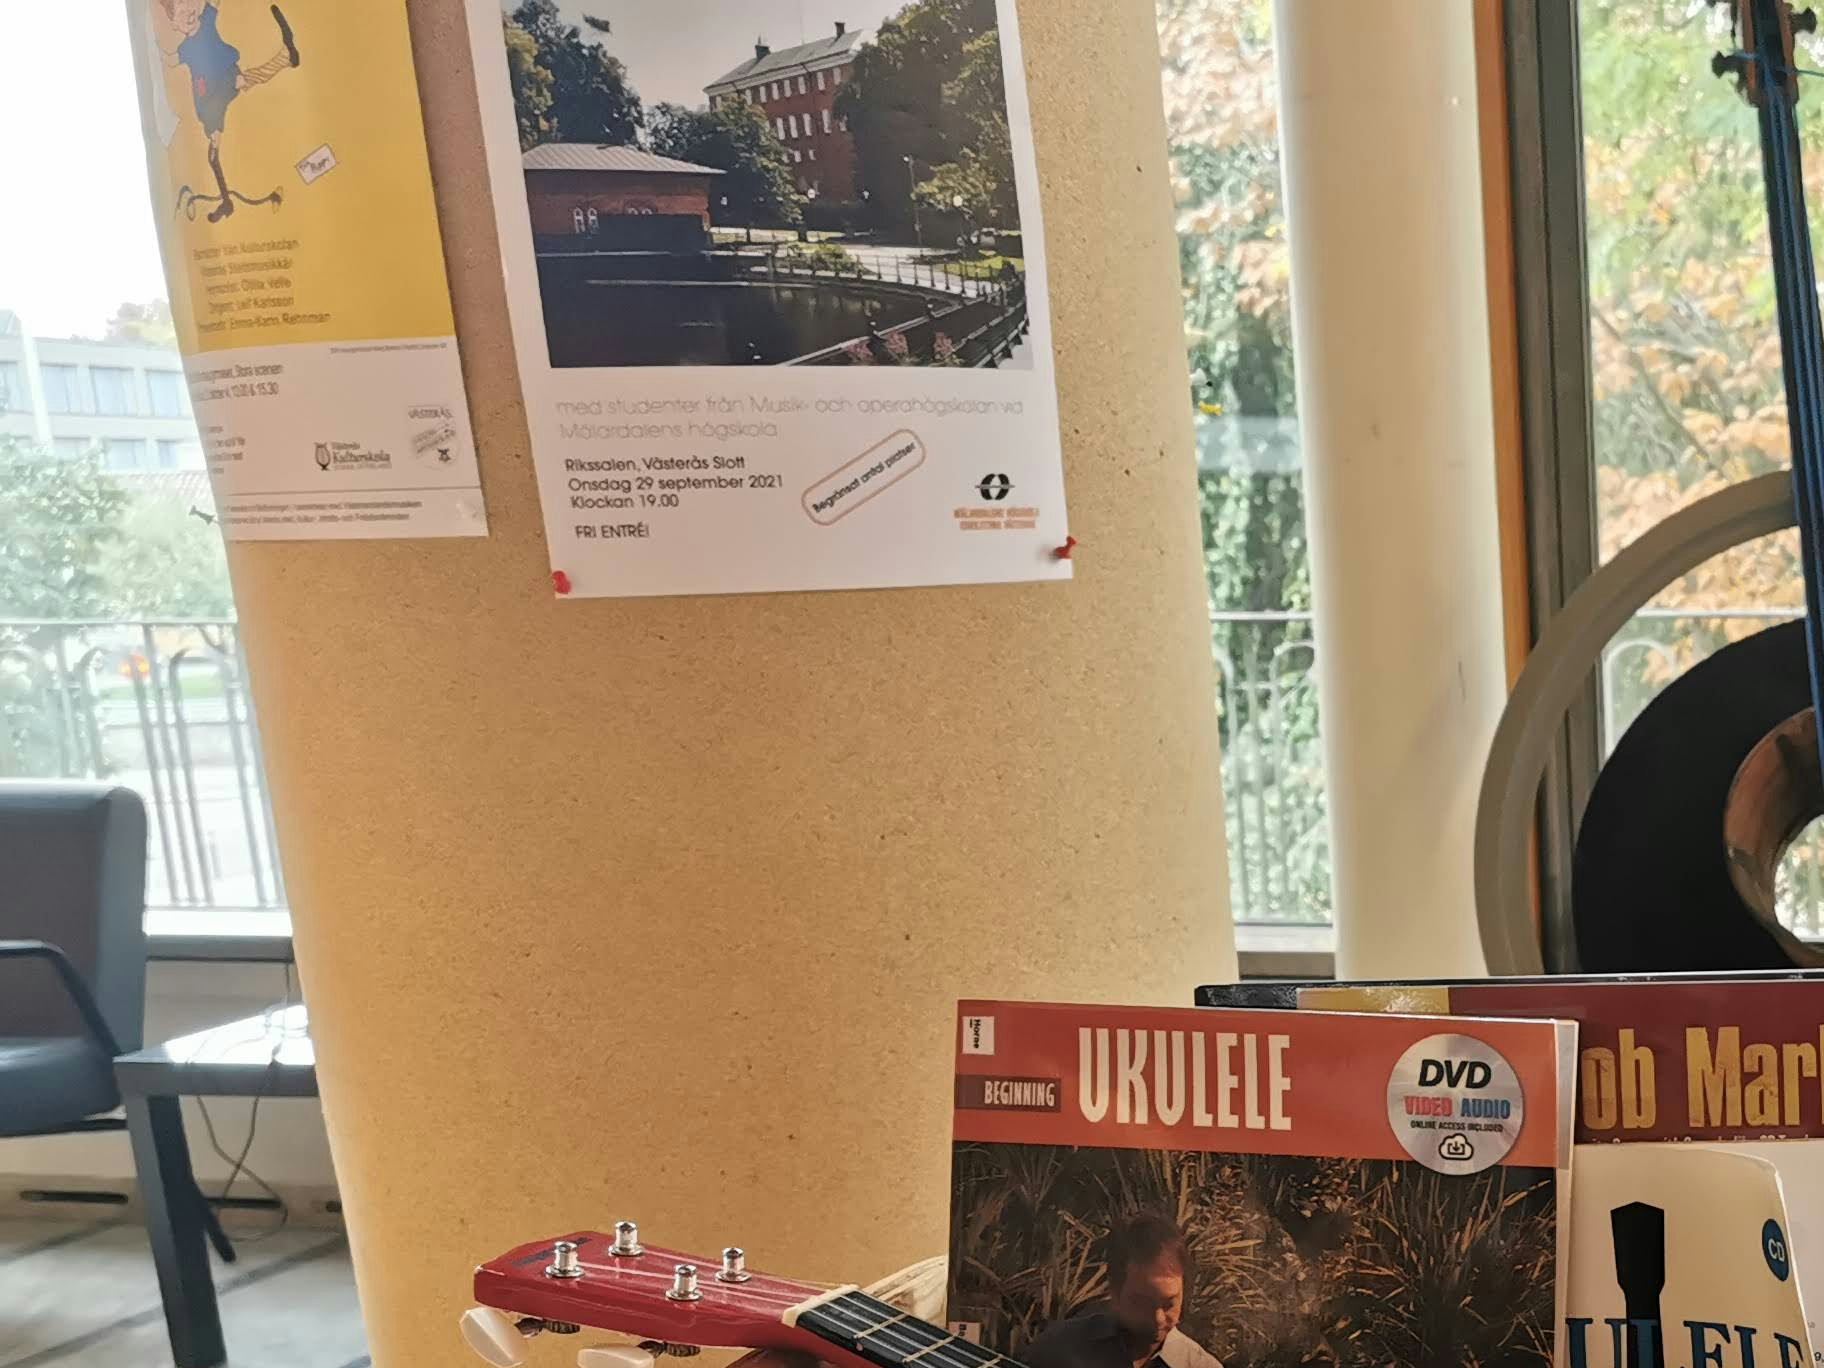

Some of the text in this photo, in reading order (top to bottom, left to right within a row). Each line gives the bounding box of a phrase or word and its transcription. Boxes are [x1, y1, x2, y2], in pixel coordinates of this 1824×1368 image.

[565, 454, 745, 473] Rikssalen, Västerås Slott
[568, 474, 783, 493] Onsdag 29 september 2021
[571, 493, 679, 509] Klockan 19.00
[575, 522, 650, 538] FRI ENTRÉ!
[1078, 1026, 1293, 1132] UKULELE
[1418, 1059, 1492, 1089] DVD
[1581, 1028, 1657, 1130] ob
[984, 1080, 1056, 1107] BEGINNING
[1403, 1095, 1511, 1120] VIDEO AUDIO
[1438, 1121, 1466, 1132] ACCESS
[1768, 1238, 1785, 1262] CD
